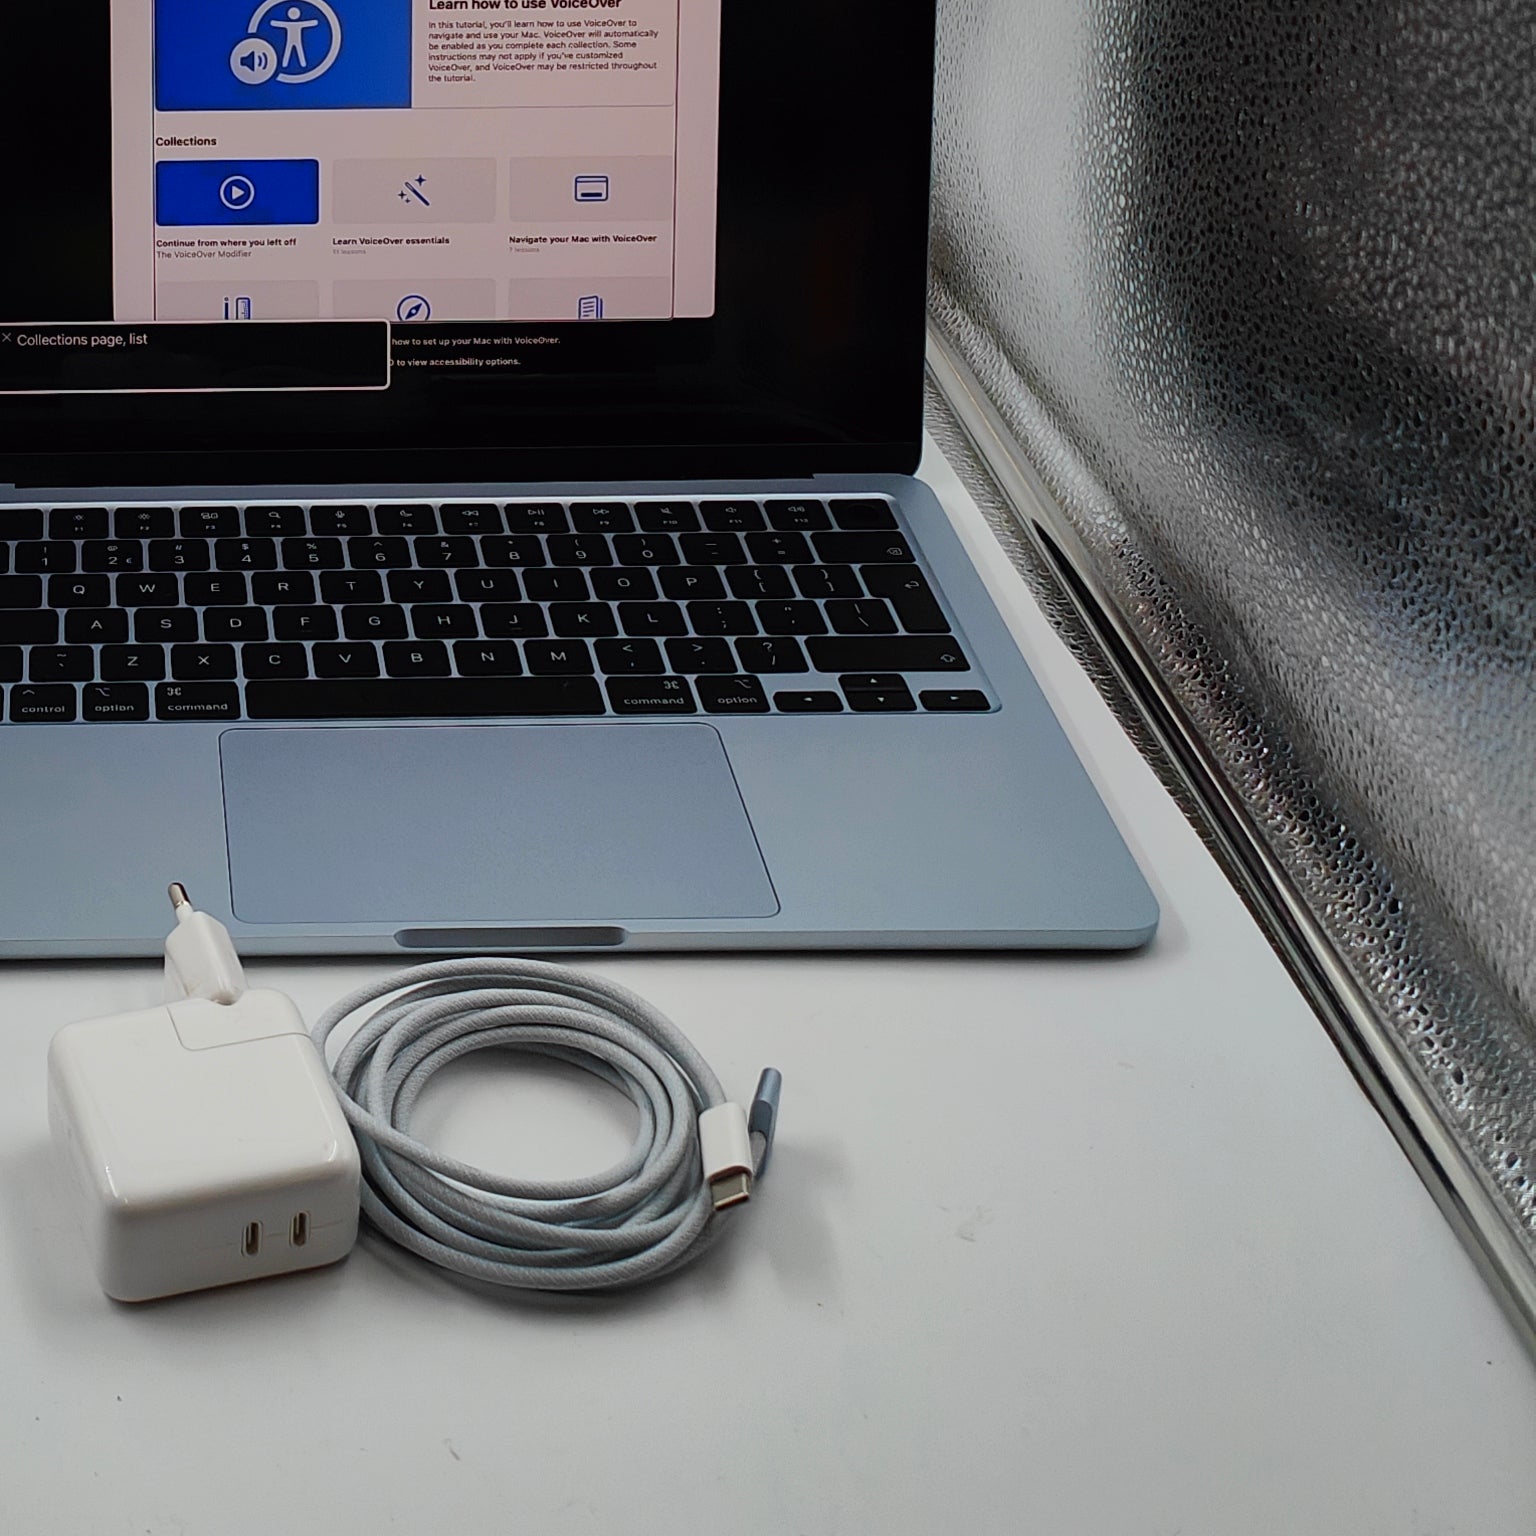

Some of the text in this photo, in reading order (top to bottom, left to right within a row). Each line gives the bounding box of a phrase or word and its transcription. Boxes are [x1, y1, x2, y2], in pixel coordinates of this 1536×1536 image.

[521, 0, 546, 8] use
[583, 18, 626, 27] VoiceOver
[428, 32, 463, 41] navigate
[500, 32, 518, 40] your
[543, 30, 585, 38] VoiceOver
[588, 29, 601, 38] will
[603, 29, 658, 39] automatically
[428, 42, 439, 50] be
[440, 42, 474, 50] enabled
[487, 43, 503, 51] you
[505, 41, 544, 50] complete
[545, 41, 566, 49] each
[612, 40, 637, 48] Some
[428, 52, 477, 60] instructions
[478, 52, 496, 60] may
[514, 52, 536, 61] apply
[538, 51, 544, 59] if
[575, 51, 623, 59] customized
[474, 63, 490, 71] and
[492, 62, 534, 71] VoiceOver
[536, 63, 554, 71] may
[556, 62, 567, 70] be
[569, 61, 609, 70] restricted
[611, 61, 657, 70] throughout
[428, 74, 441, 82] the
[155, 135, 216, 146] Collections
[156, 239, 195, 247] Continue
[332, 237, 357, 245] Learn
[405, 236, 449, 244] essentials
[509, 235, 547, 244] Navigate
[549, 236, 569, 244] your
[612, 234, 657, 242] VoiceOver
[156, 249, 251, 258] The VoiceOver Modifier
[16, 332, 147, 347] Collections page, list
[451, 338, 471, 346] your
[407, 358, 427, 366] view
[429, 357, 484, 367] accessibility
[241, 554, 251, 562] 4
[308, 553, 319, 562] 5
[374, 552, 386, 562] 6
[442, 552, 452, 560] 7
[508, 551, 520, 560] 8
[575, 550, 586, 559] 9
[641, 549, 653, 558] 0
[107, 556, 118, 565] 2
[174, 555, 185, 564] 3
[277, 582, 289, 591] R
[345, 581, 356, 590] T
[413, 580, 424, 589] Y
[480, 579, 494, 588] U
[617, 577, 630, 587] O
[685, 577, 697, 586] P
[72, 584, 85, 595] Q
[138, 583, 156, 593] W
[210, 582, 220, 592] E
[300, 616, 309, 626] F
[368, 615, 381, 626] G
[437, 615, 451, 625] H
[508, 614, 518, 624] J
[577, 613, 590, 623] K
[646, 613, 658, 622] L
[90, 619, 102, 629] A
[160, 618, 172, 629] S
[229, 618, 242, 628] D
[127, 655, 138, 666] Z
[197, 655, 209, 665] X
[268, 654, 281, 665] C
[338, 653, 351, 663] V
[410, 652, 423, 663] B
[480, 651, 495, 661] N
[550, 651, 567, 661] M
[623, 697, 684, 705] command
[716, 696, 757, 704] option
[21, 705, 65, 713] control
[94, 704, 134, 712] option
[167, 703, 228, 711] command
